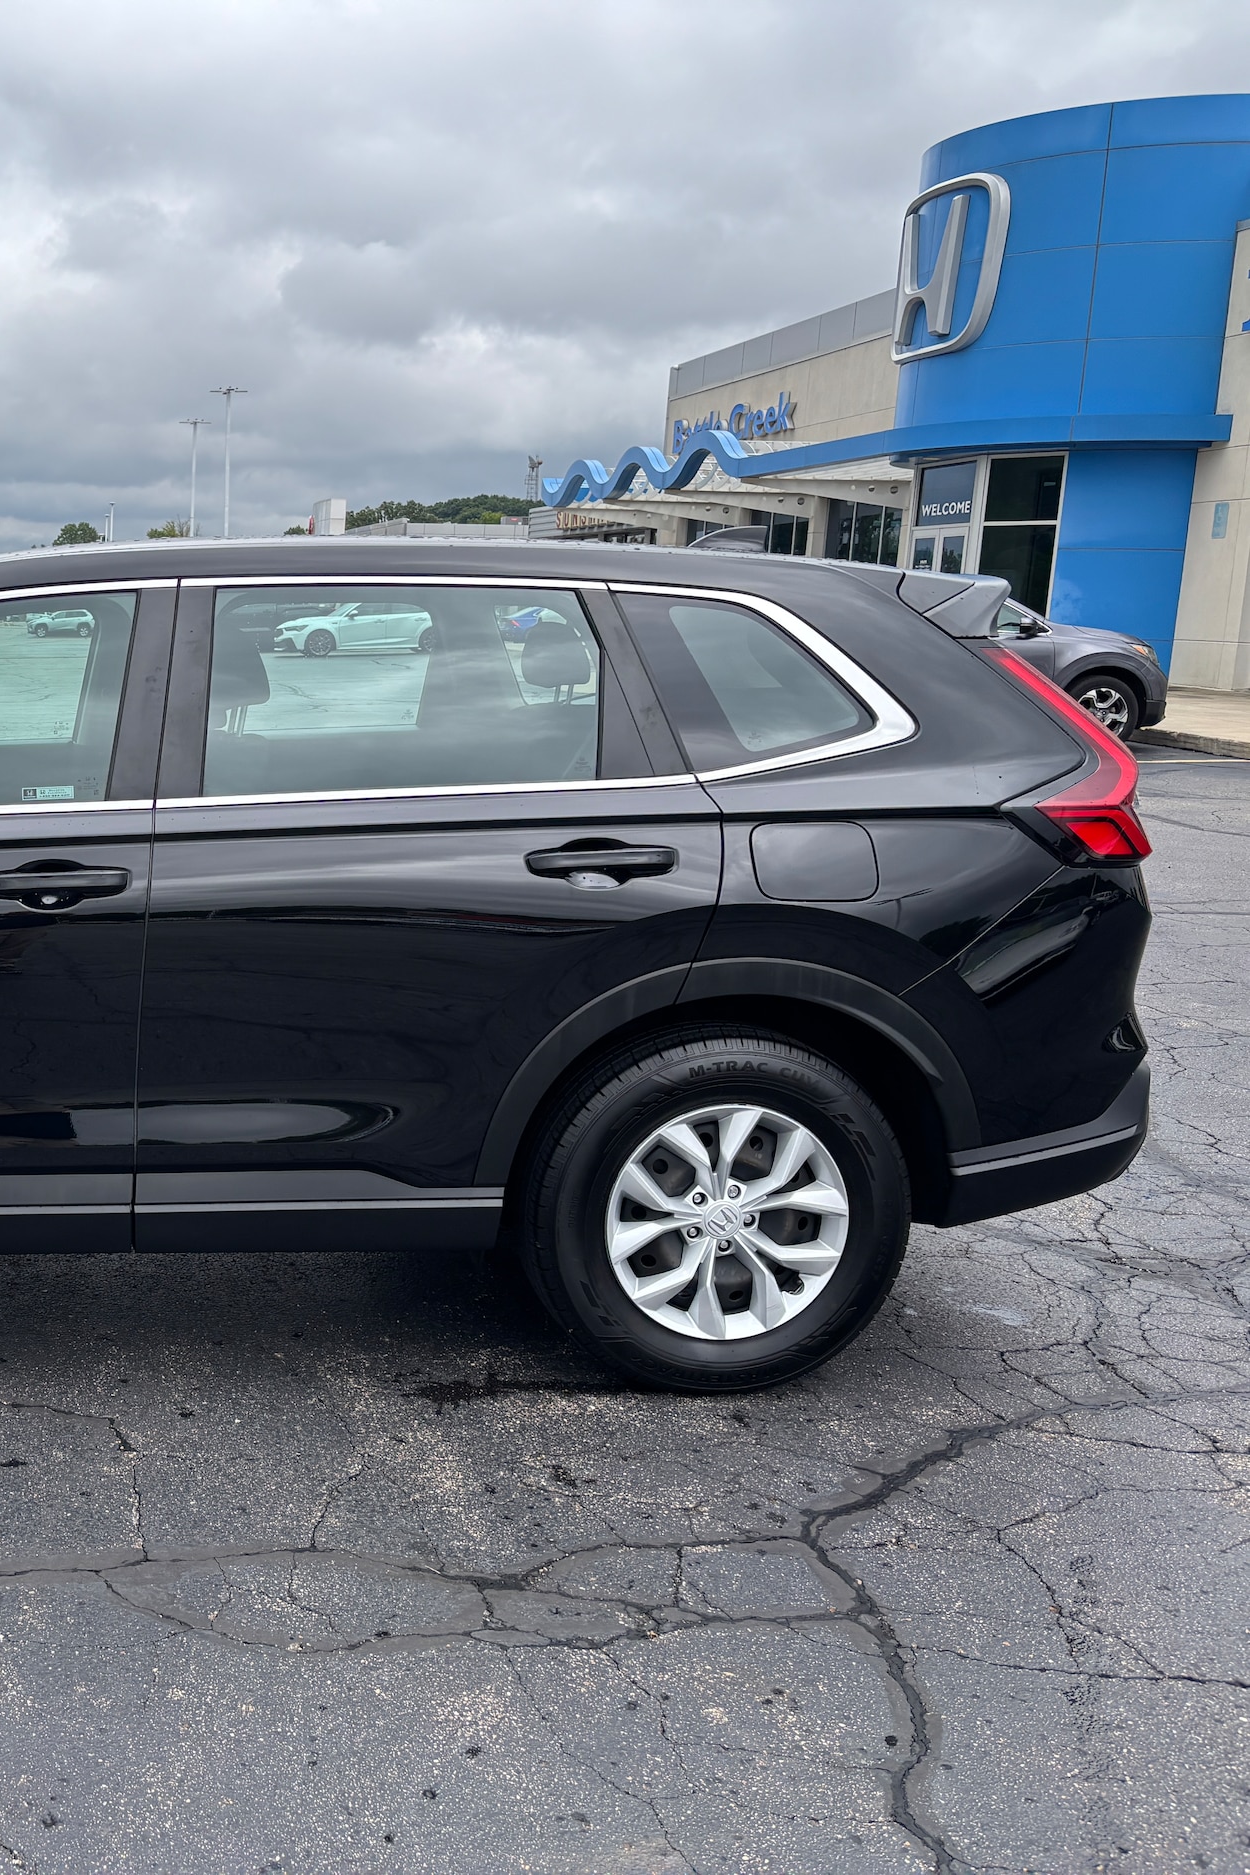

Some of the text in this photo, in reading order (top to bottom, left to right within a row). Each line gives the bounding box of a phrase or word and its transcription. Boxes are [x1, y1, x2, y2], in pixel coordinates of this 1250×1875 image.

[729, 391, 795, 441] Creek
[922, 501, 971, 516] WELCOME
[688, 1061, 768, 1079] M-TRAC
